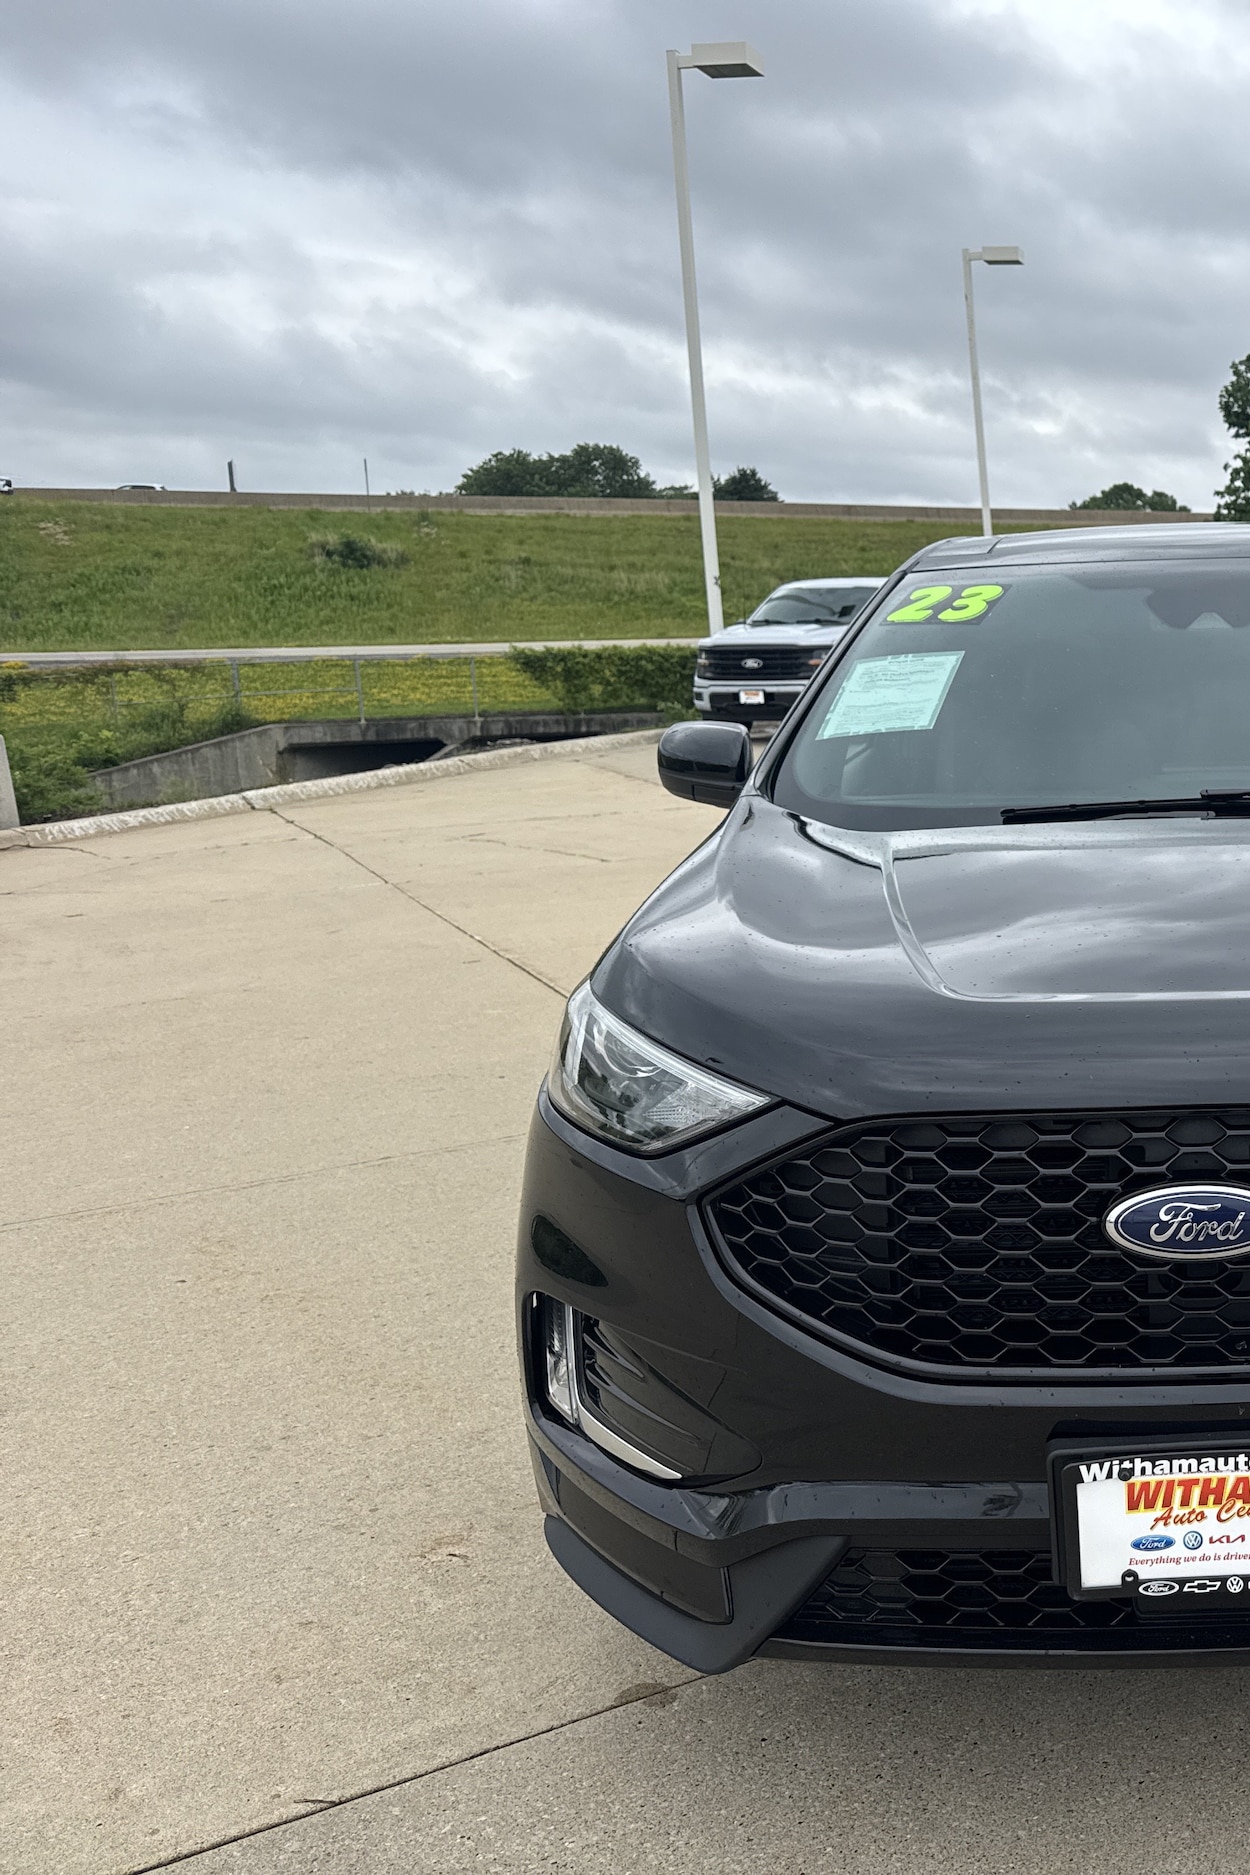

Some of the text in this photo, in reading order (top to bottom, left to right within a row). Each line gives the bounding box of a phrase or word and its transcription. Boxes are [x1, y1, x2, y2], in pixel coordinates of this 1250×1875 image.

[886, 584, 1004, 623] 23
[1149, 1202, 1246, 1243] Ford
[1150, 1507, 1208, 1530] Auto
[1139, 1536, 1167, 1549] Ford
[1128, 1555, 1182, 1567] Everything
[1183, 1555, 1197, 1563] we
[1200, 1553, 1212, 1562] do
[1213, 1552, 1221, 1561] is
